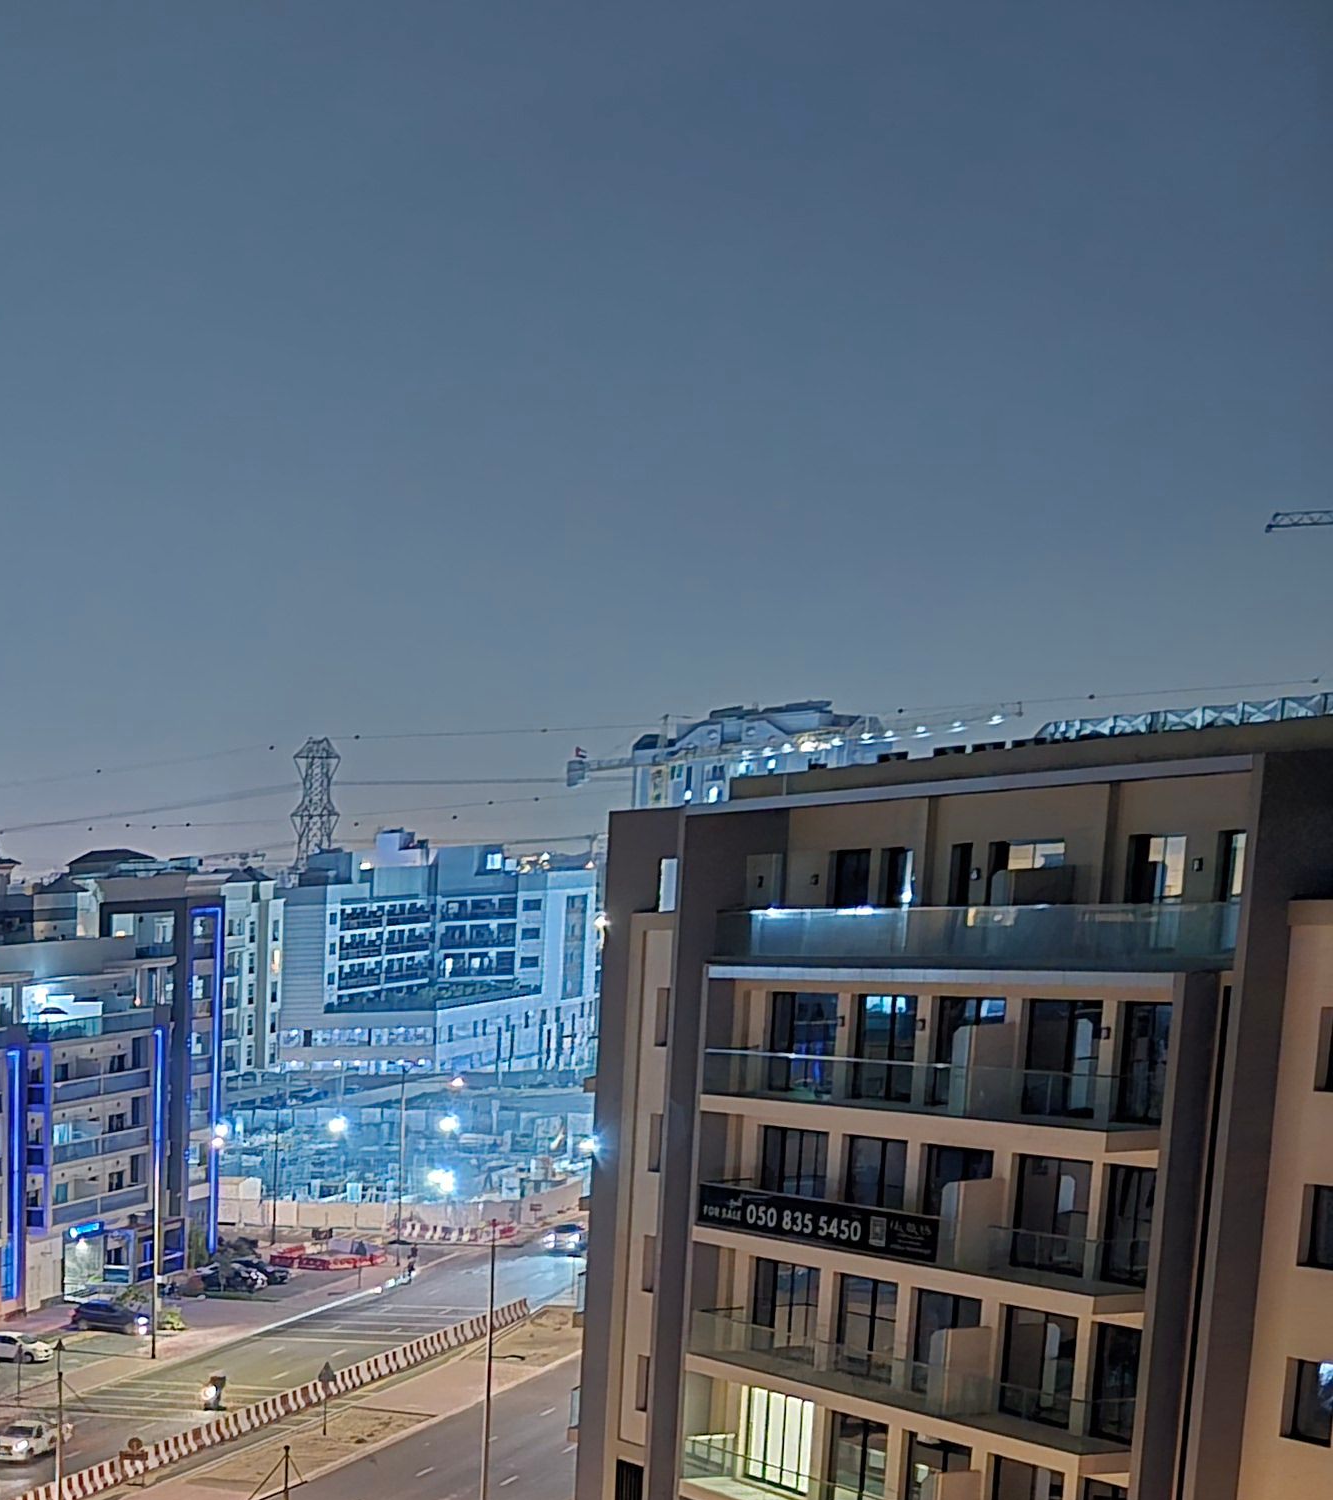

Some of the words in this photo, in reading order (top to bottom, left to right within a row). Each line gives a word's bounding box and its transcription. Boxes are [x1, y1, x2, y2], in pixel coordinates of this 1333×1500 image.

[703, 1204, 720, 1218] FOR
[721, 1207, 742, 1221] SALE
[746, 1203, 778, 1228] 050
[782, 1209, 813, 1235] 835
[817, 1215, 862, 1242] 5450
